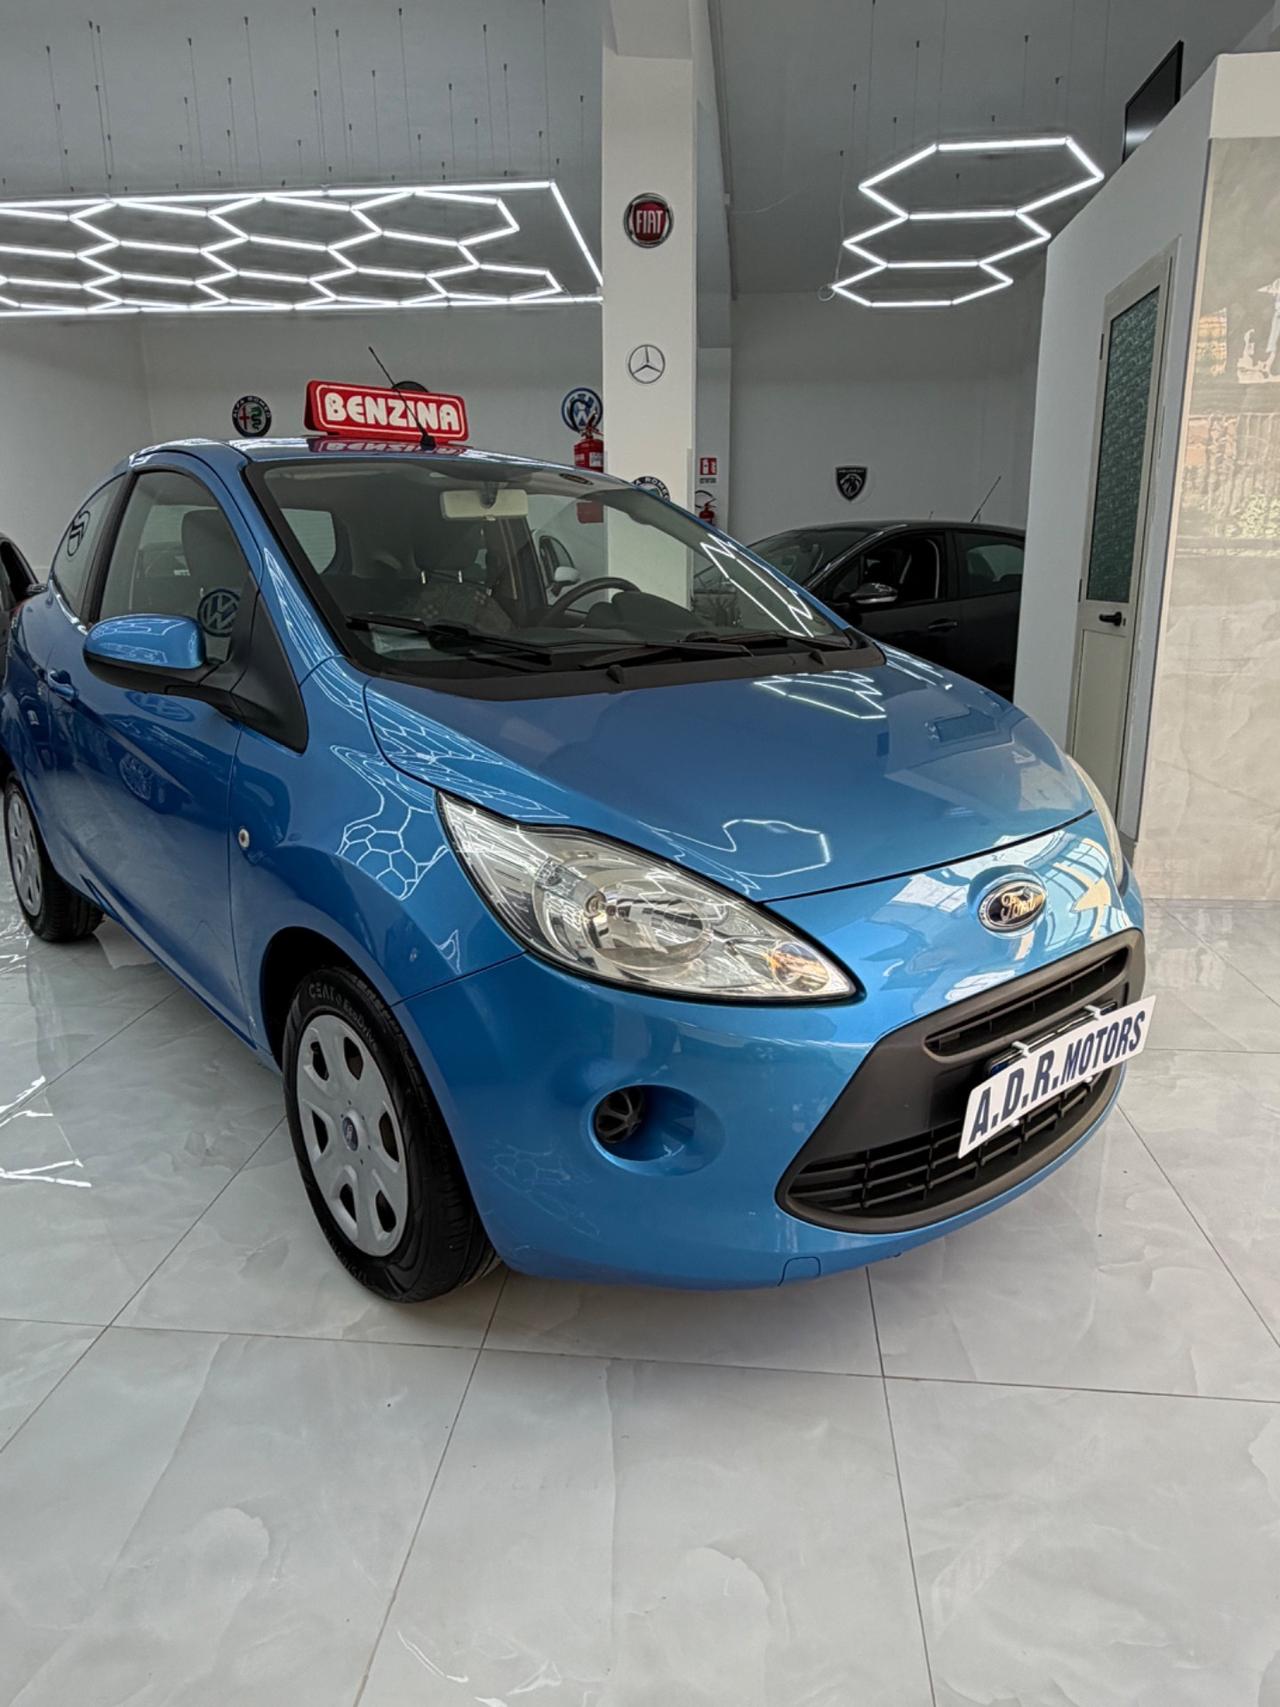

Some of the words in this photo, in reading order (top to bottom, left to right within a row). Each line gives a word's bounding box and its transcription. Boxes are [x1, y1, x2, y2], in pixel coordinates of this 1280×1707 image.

[636, 210, 664, 234] FIAT
[324, 392, 460, 431] BENZINA
[1000, 888, 1037, 921] Ford
